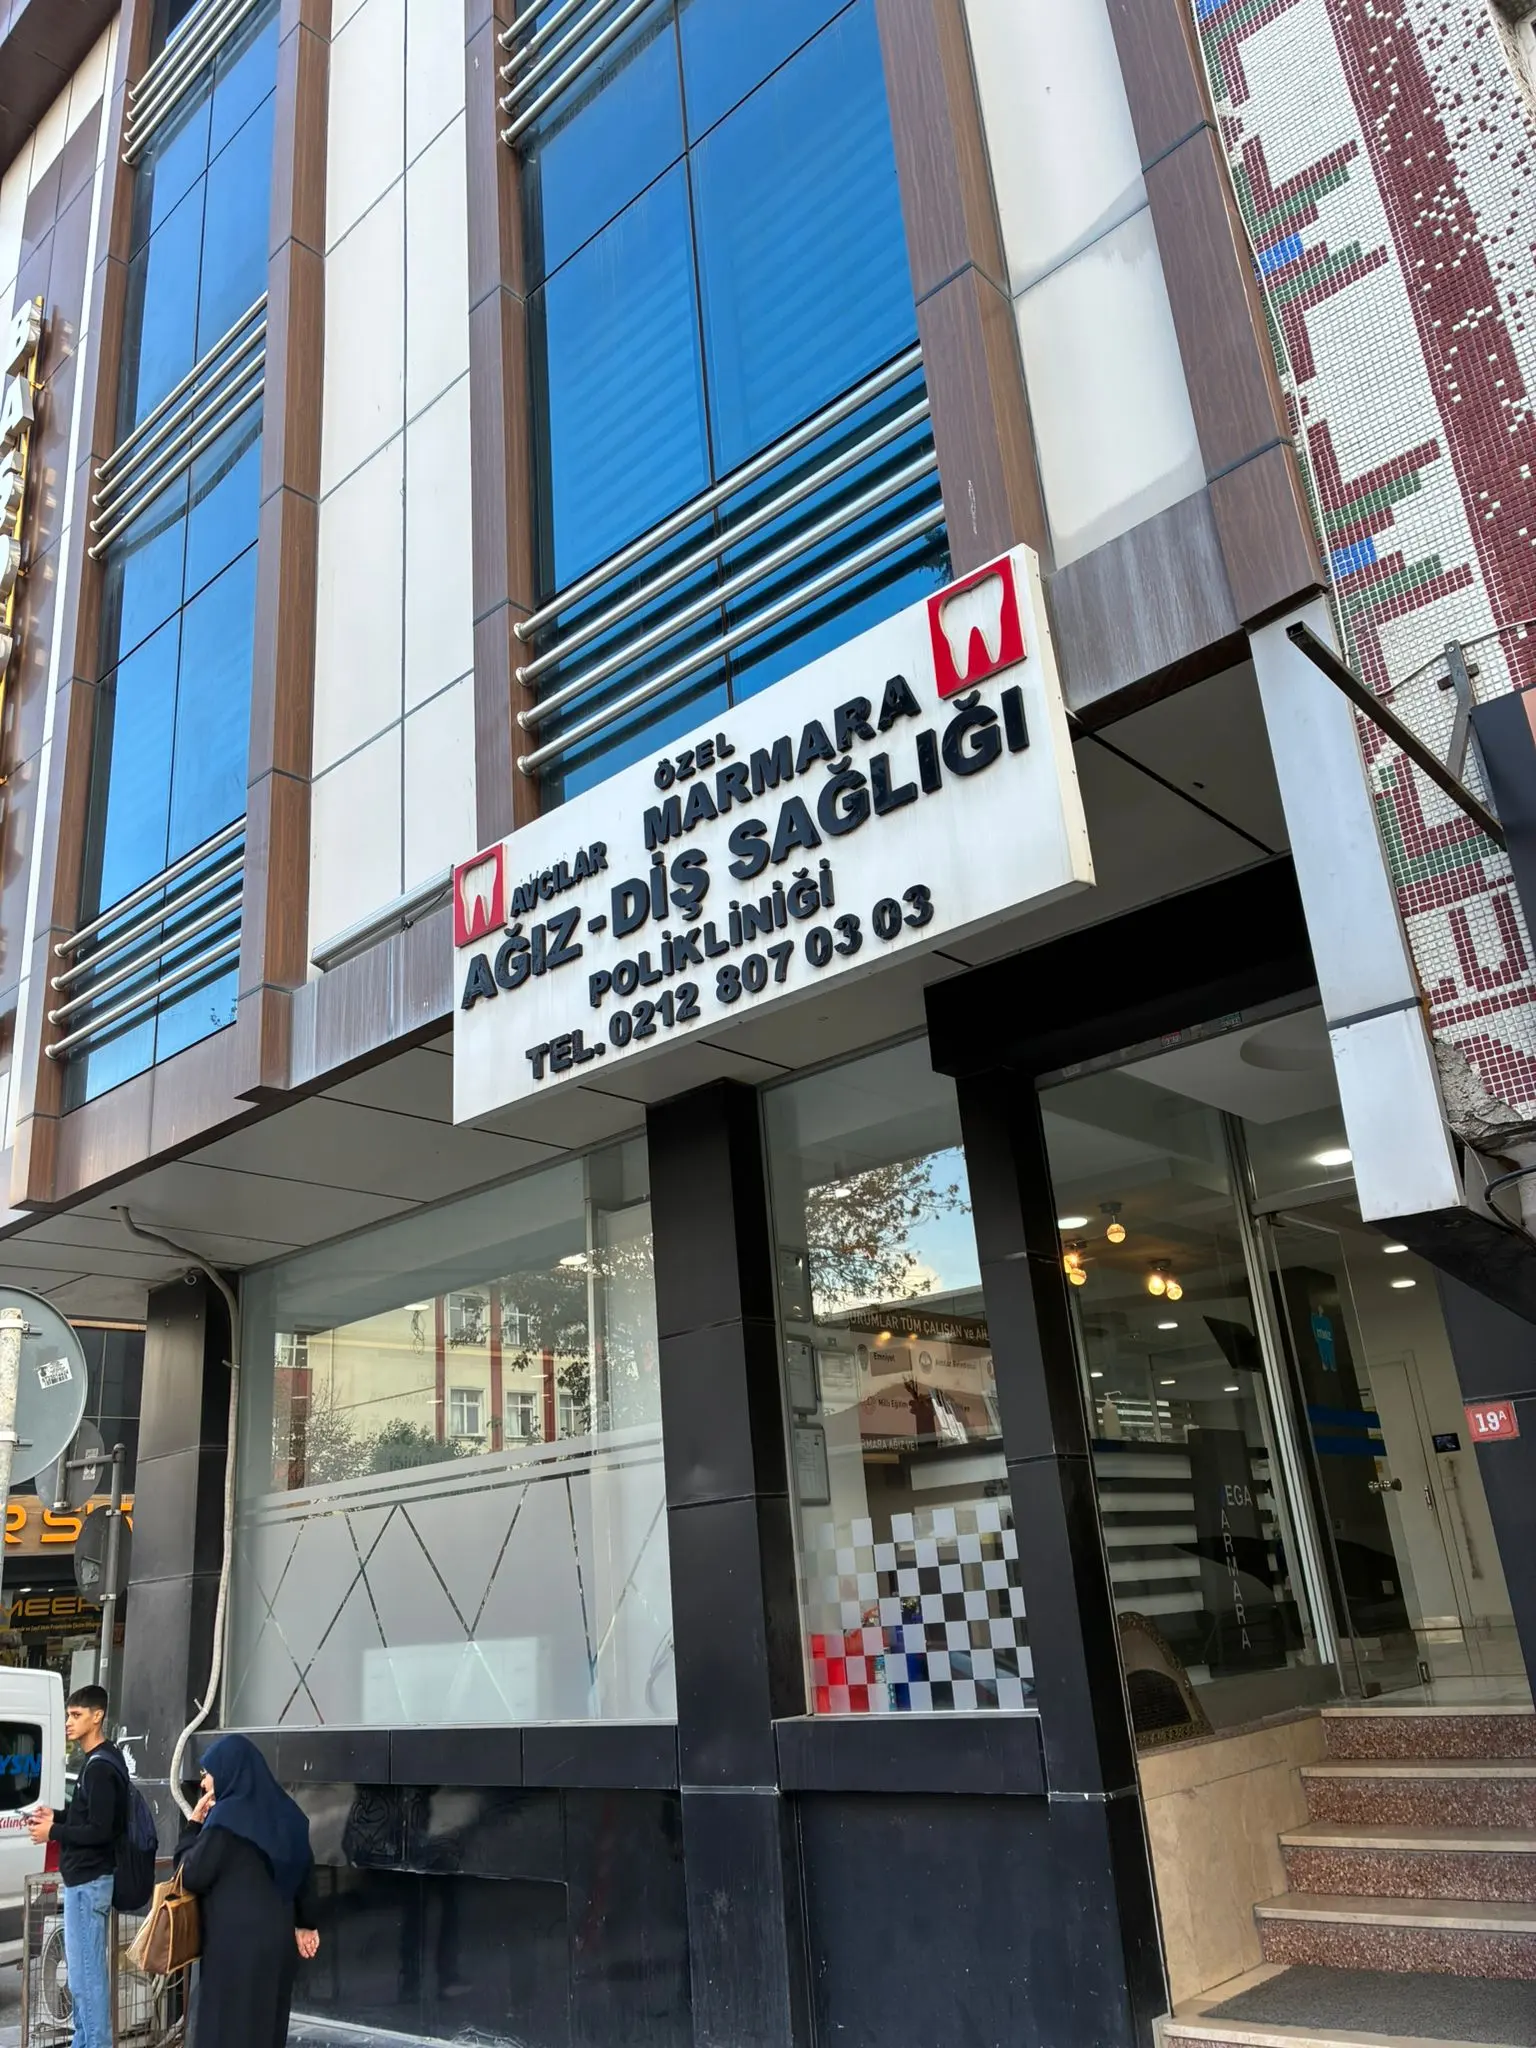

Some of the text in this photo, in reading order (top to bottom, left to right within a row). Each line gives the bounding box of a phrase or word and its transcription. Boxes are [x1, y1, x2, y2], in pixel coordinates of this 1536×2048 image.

[511, 674, 922, 919] AVCILAR MARMARA
[653, 732, 736, 791] ÖZEL
[728, 686, 1030, 881] SAĞLIĞI
[525, 884, 935, 1081] TEL. 0212 807 03 03
[588, 858, 836, 1008] POLİKLİNİĞİ
[900, 1315, 921, 1332] TÜM
